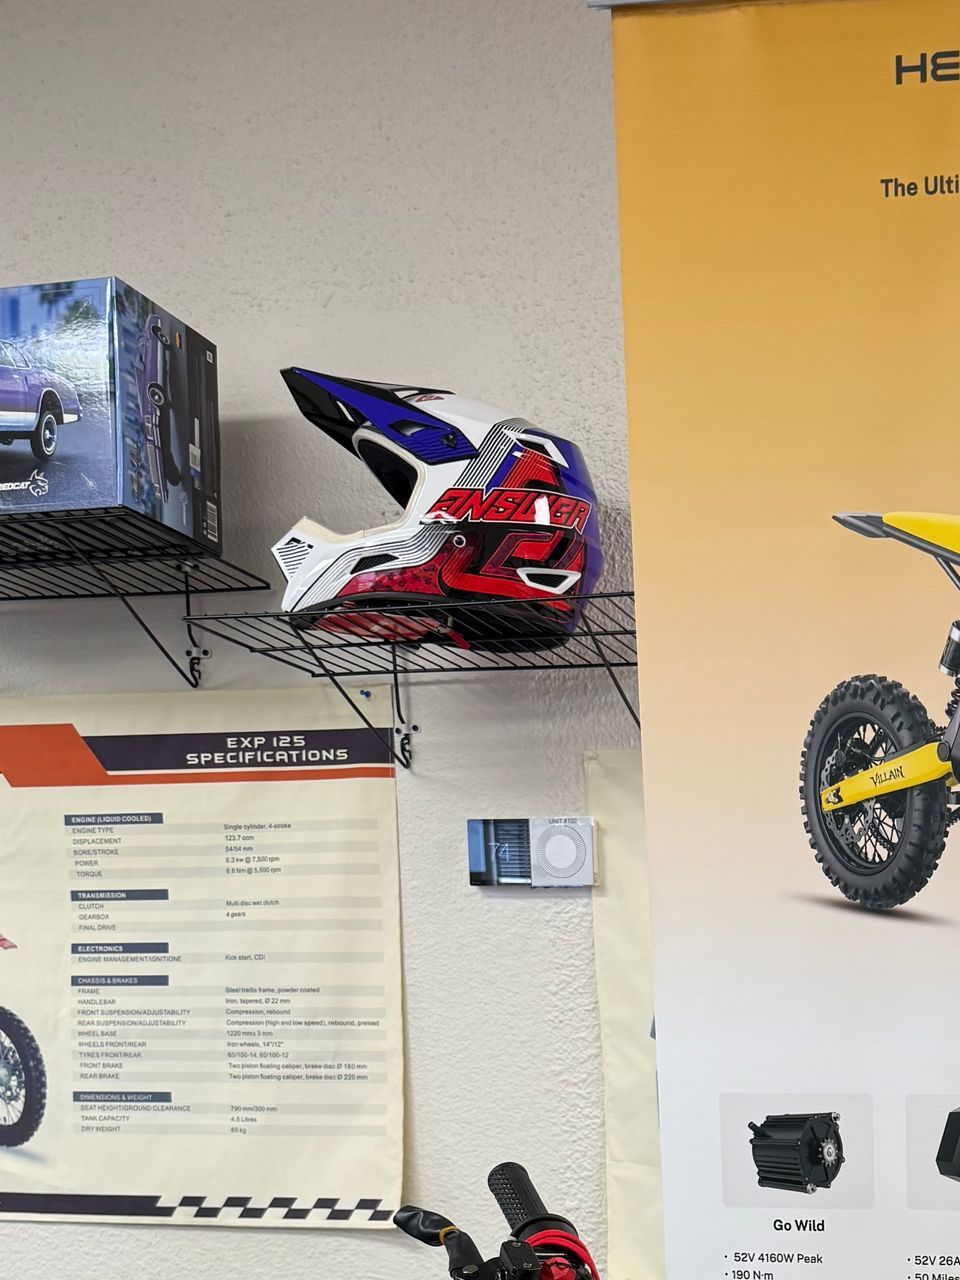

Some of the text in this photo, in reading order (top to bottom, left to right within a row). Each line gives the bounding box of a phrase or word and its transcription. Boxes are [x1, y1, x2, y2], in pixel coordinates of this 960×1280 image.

[880, 177, 918, 199] The
[422, 488, 592, 534] ANSWER
[227, 735, 306, 749] EXP 125
[186, 749, 349, 766] SPECIFICATIONS
[870, 765, 906, 788] VILLAIN
[773, 1219, 825, 1233] Go Wild
[733, 1252, 823, 1265] 52V 4160W Peak
[914, 1255, 937, 1267] 52V
[732, 1269, 751, 1280] 190
